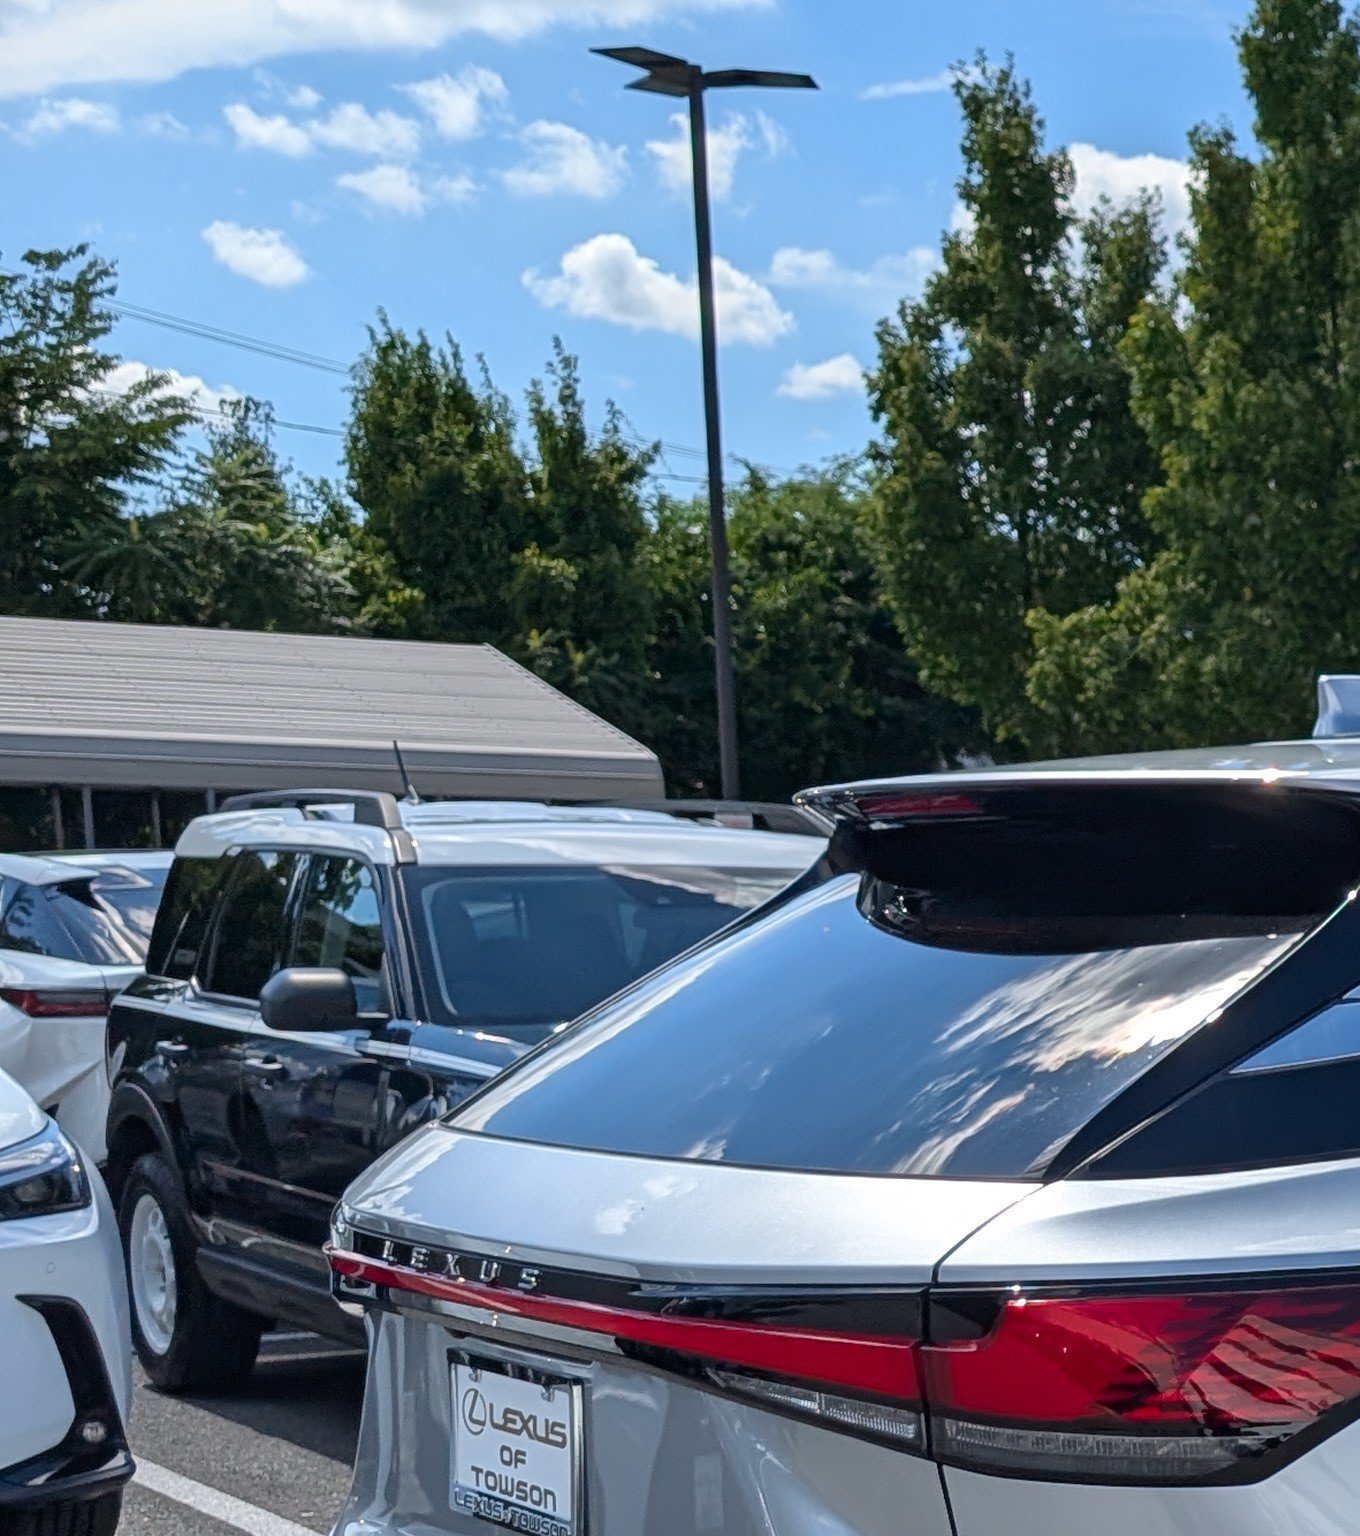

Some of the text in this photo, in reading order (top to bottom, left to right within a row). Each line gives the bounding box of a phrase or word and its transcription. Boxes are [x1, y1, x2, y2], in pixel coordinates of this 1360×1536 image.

[382, 1239, 542, 1290] LEXUS
[489, 1402, 567, 1449] LEXUS
[500, 1445, 526, 1469] OF
[455, 1487, 503, 1521] LEXUS
[471, 1465, 557, 1512] TOWSON
